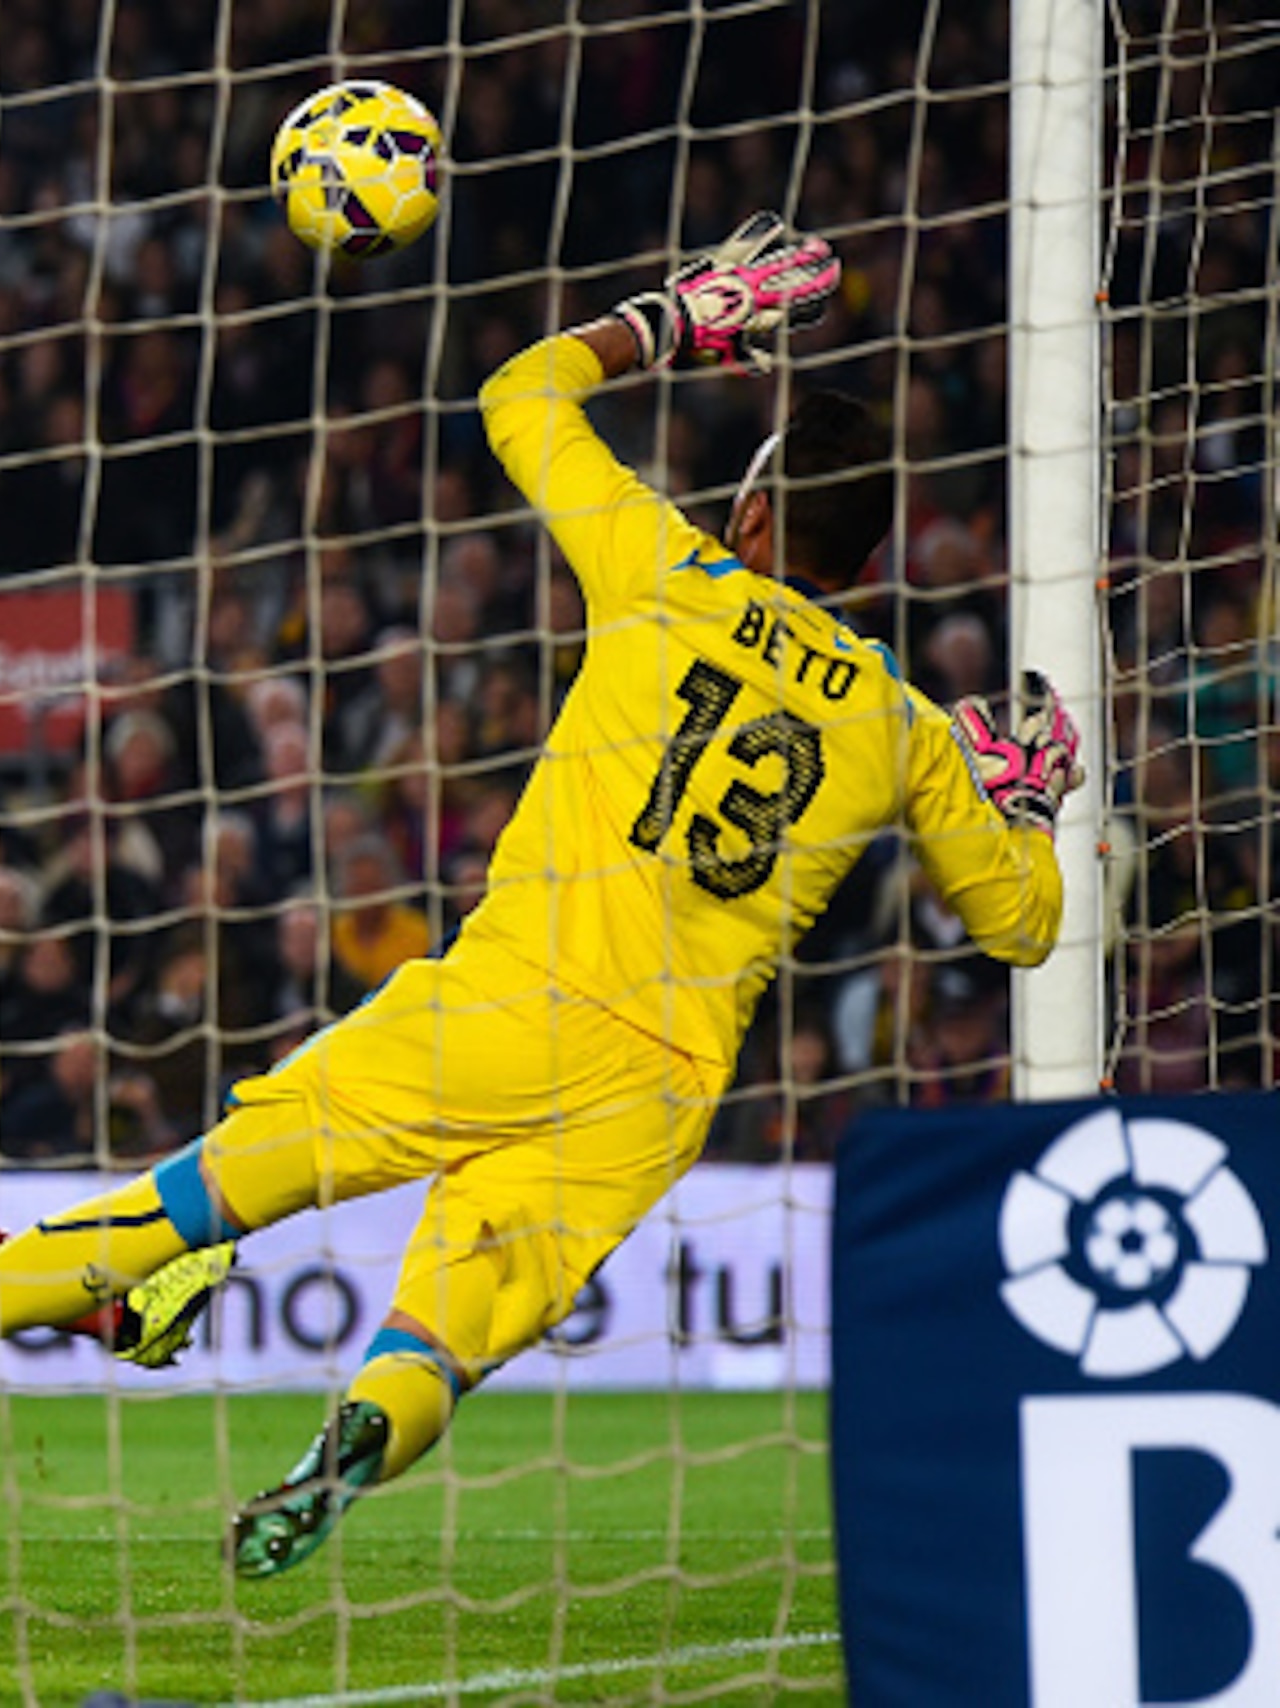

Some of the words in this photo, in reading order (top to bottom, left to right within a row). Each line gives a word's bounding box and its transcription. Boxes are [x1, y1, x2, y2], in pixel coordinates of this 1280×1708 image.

[732, 600, 858, 700] BETO
[629, 658, 824, 901] 13
[665, 1238, 786, 1348] tu
